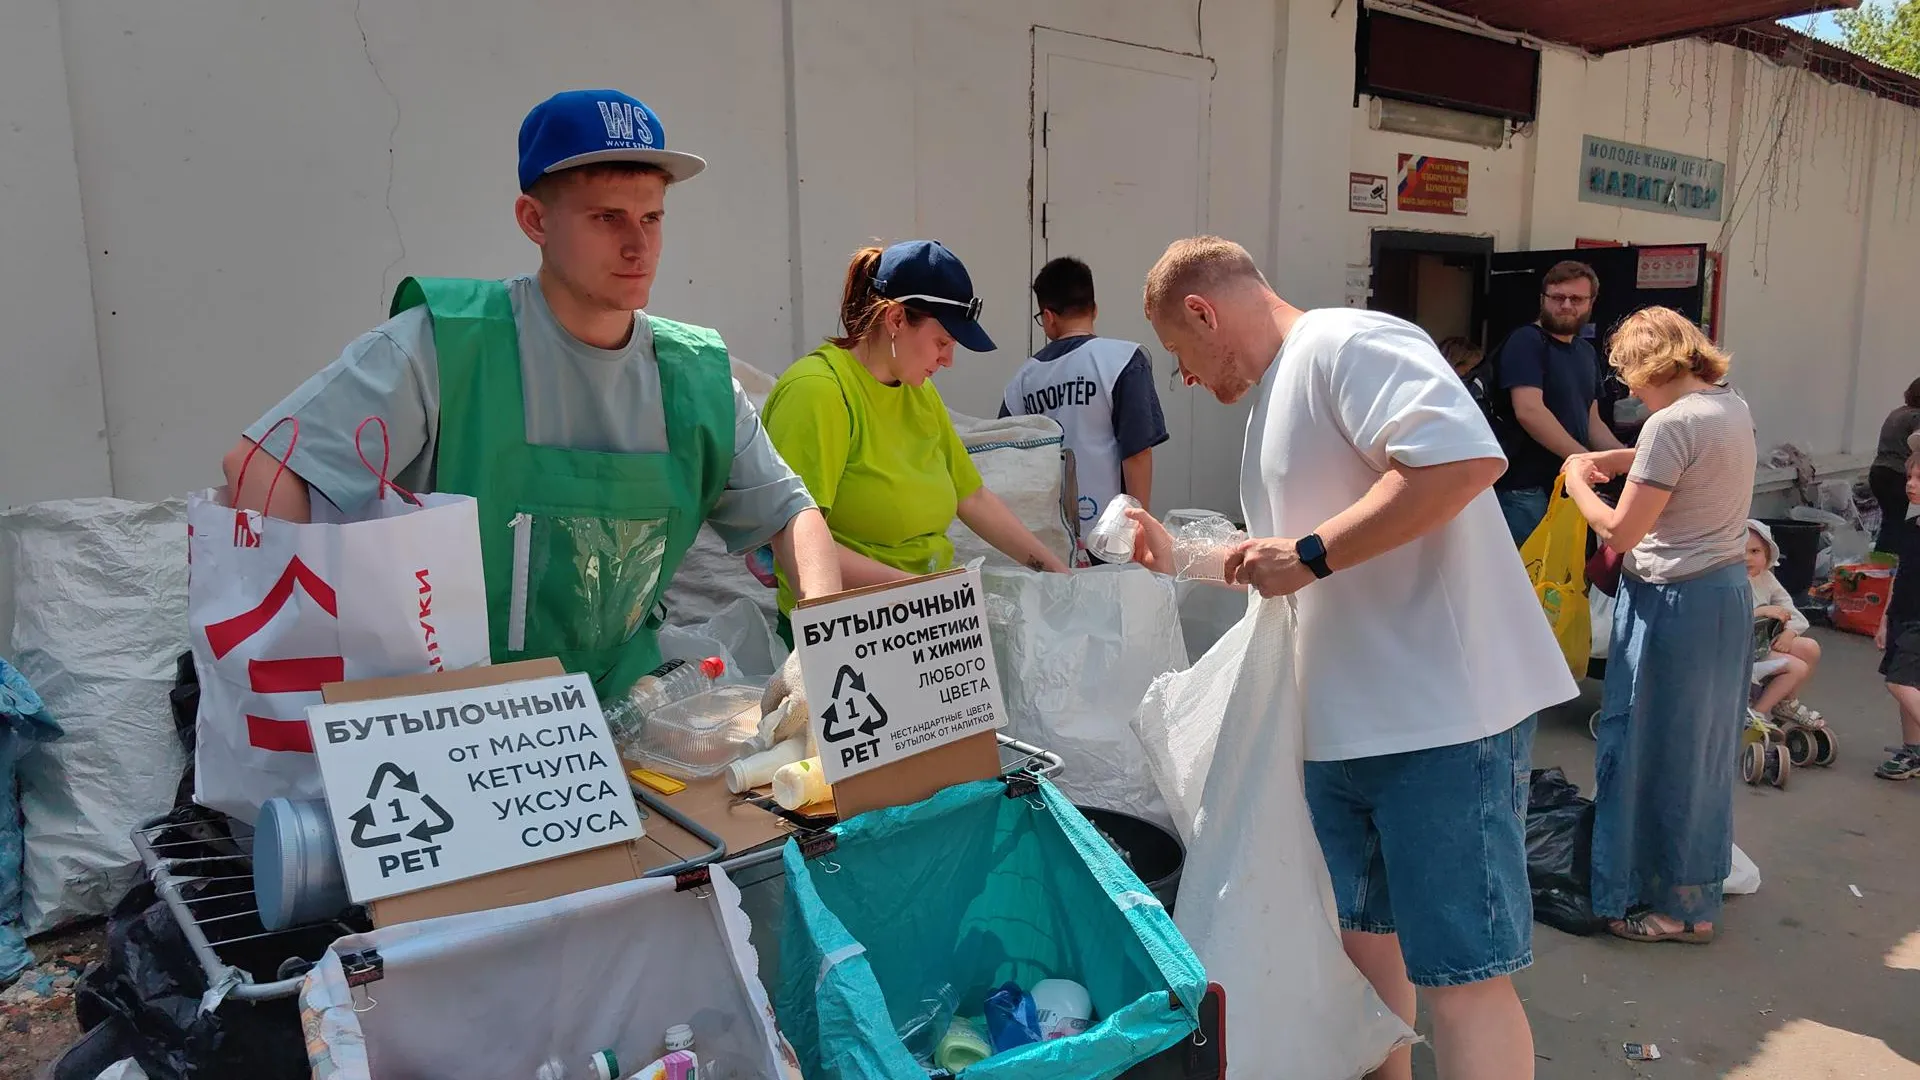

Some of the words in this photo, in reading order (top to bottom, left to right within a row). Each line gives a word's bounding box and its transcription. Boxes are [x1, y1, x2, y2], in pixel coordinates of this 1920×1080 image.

[597, 101, 653, 144] WS
[605, 140, 631, 148] WAVE
[803, 583, 976, 647] БУТЫЛОЧНЫЙ
[882, 615, 980, 652] КОСМЕТИКИ
[912, 649, 925, 664] И
[928, 633, 983, 660] ХИМИИ
[918, 657, 986, 689] ЛЮБОГО
[939, 677, 990, 704] ЦВЕТА
[325, 684, 587, 744] БУТЫЛОЧНЫЙ
[845, 697, 860, 719] 1
[890, 710, 962, 741] НЕСТАНДАРТНЫЕ
[966, 702, 993, 717] ЦВЕТА
[488, 722, 598, 756] МАСЛА
[895, 730, 936, 751] БУТЫЛОК
[938, 726, 949, 737] ОТ
[951, 712, 995, 733] НАПИТКОВ
[467, 750, 608, 792] КЕТЧУПА
[387, 798, 410, 824] 1
[491, 780, 618, 821] УКСУСА
[521, 809, 628, 848] СОУСА
